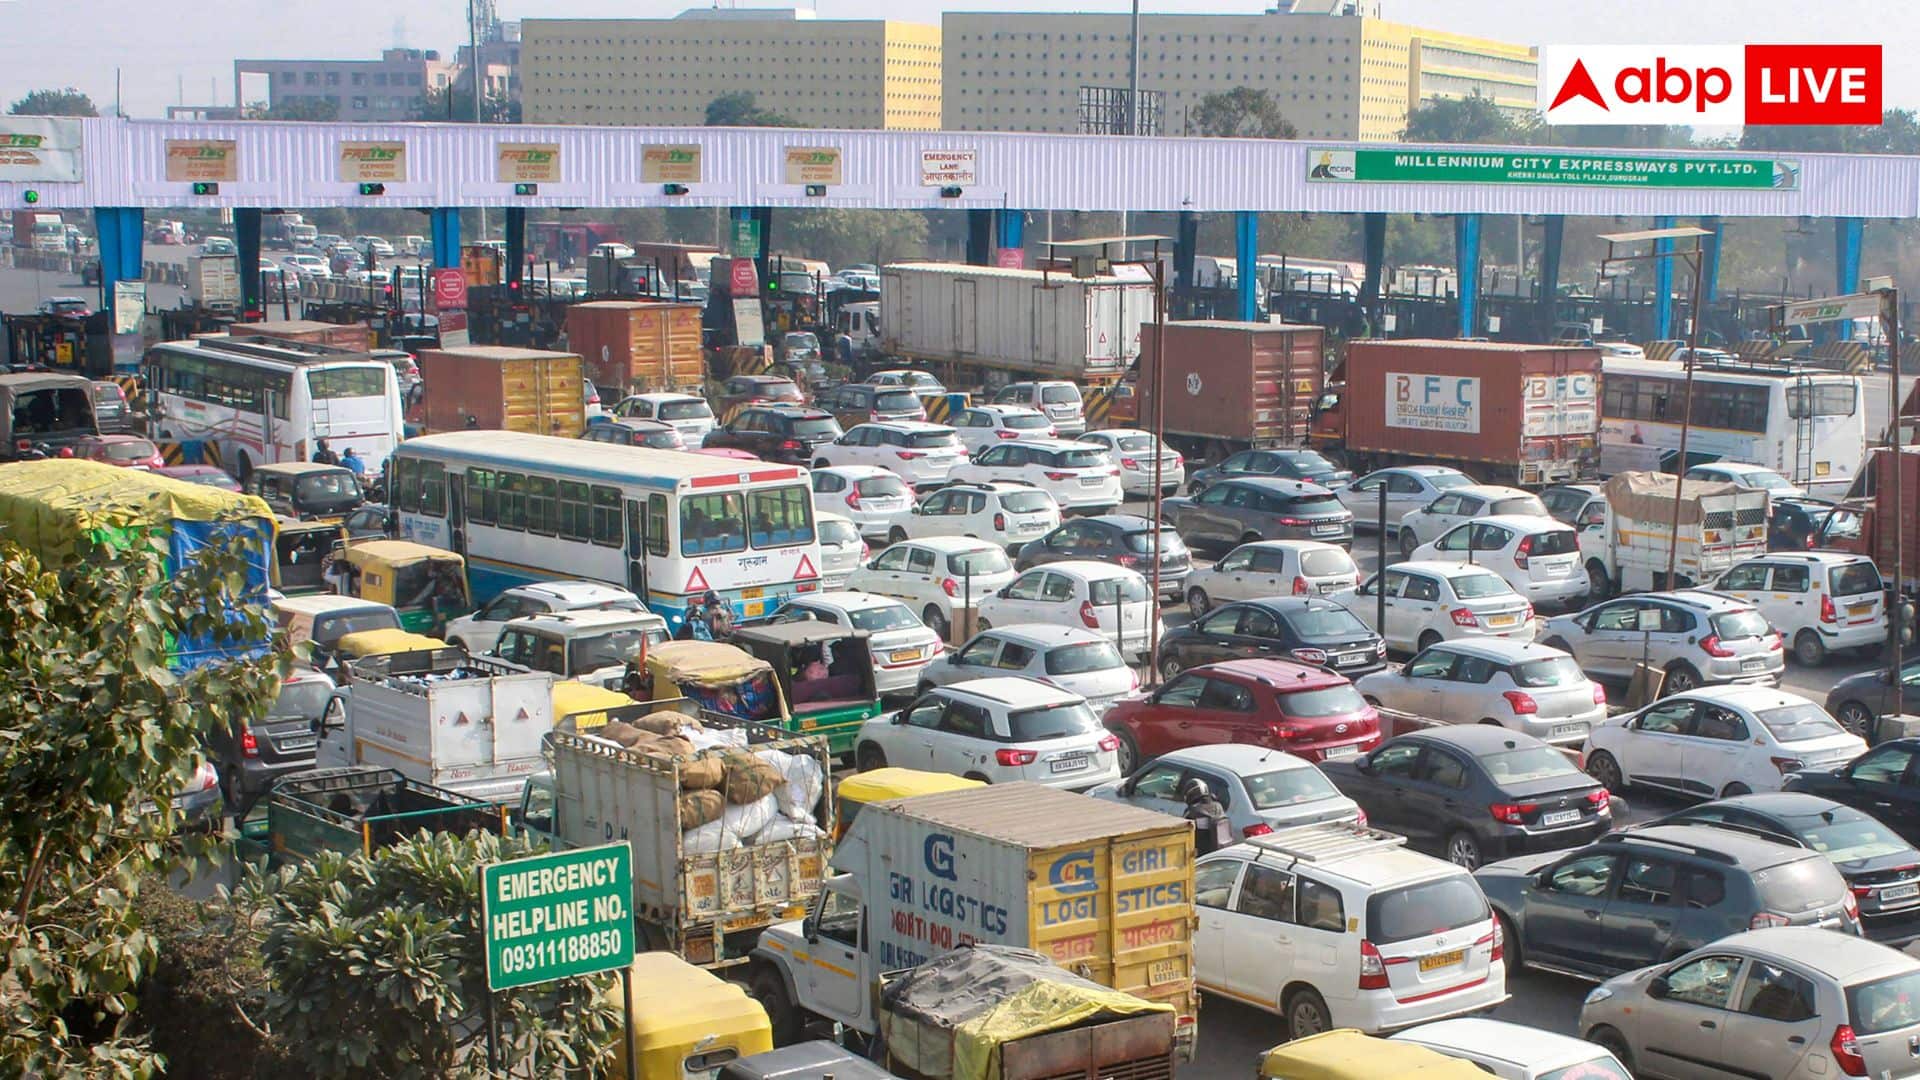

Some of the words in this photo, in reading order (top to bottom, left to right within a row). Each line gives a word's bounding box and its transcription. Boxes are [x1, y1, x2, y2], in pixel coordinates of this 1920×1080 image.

[1395, 155, 1504, 168] MILLENNIUM
[1512, 158, 1551, 169] CITY
[1559, 159, 1678, 173] EXPRESSWAYS
[1122, 848, 1166, 874] GIRI
[498, 857, 619, 902] EMERGENCY
[493, 899, 589, 941] HELPLINE
[593, 894, 627, 923] NO.
[502, 929, 621, 974] 09311188850
[1051, 933, 1097, 960] डाक
